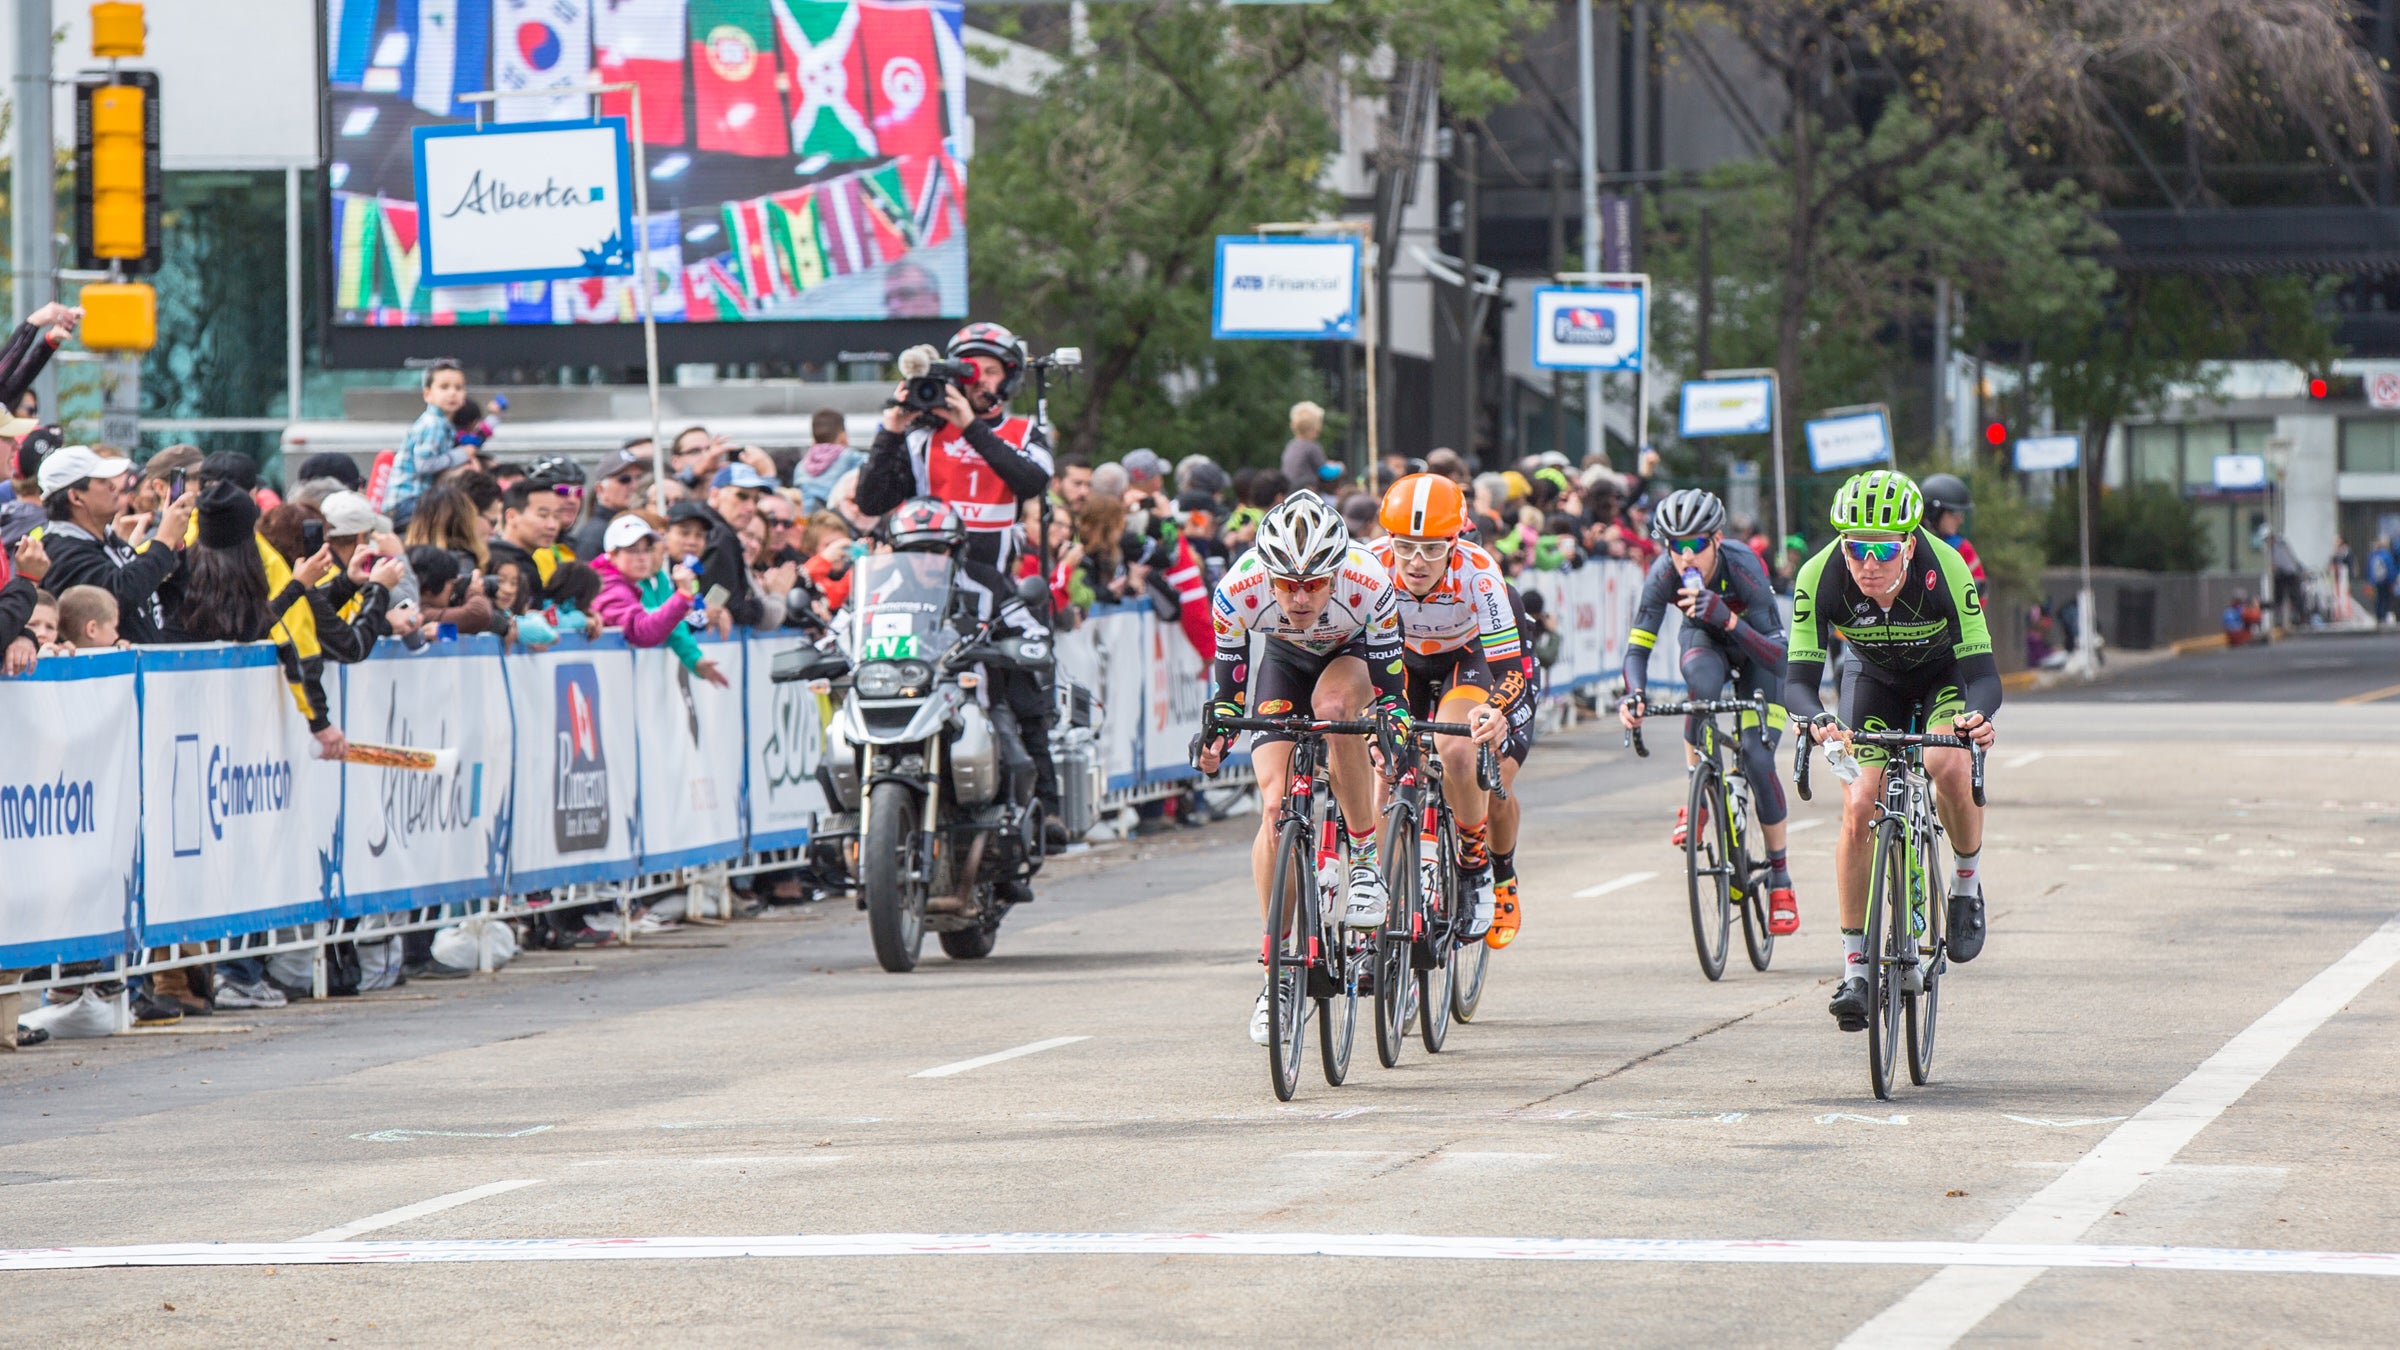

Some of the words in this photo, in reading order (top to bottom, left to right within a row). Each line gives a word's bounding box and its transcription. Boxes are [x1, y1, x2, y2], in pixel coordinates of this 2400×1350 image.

[439, 170, 592, 218] Alberta
[968, 471, 979, 497] 1
[960, 506, 981, 518] TV
[1229, 573, 1264, 597] MAXXIS
[1343, 569, 1380, 591] MAXXIS
[1484, 592, 1502, 631] Auto.ca
[866, 636, 900, 658] TV
[905, 635, 919, 657] 1
[556, 731, 607, 818] Pomeroy
[0, 769, 95, 839] monton
[206, 744, 291, 841] Edmonton
